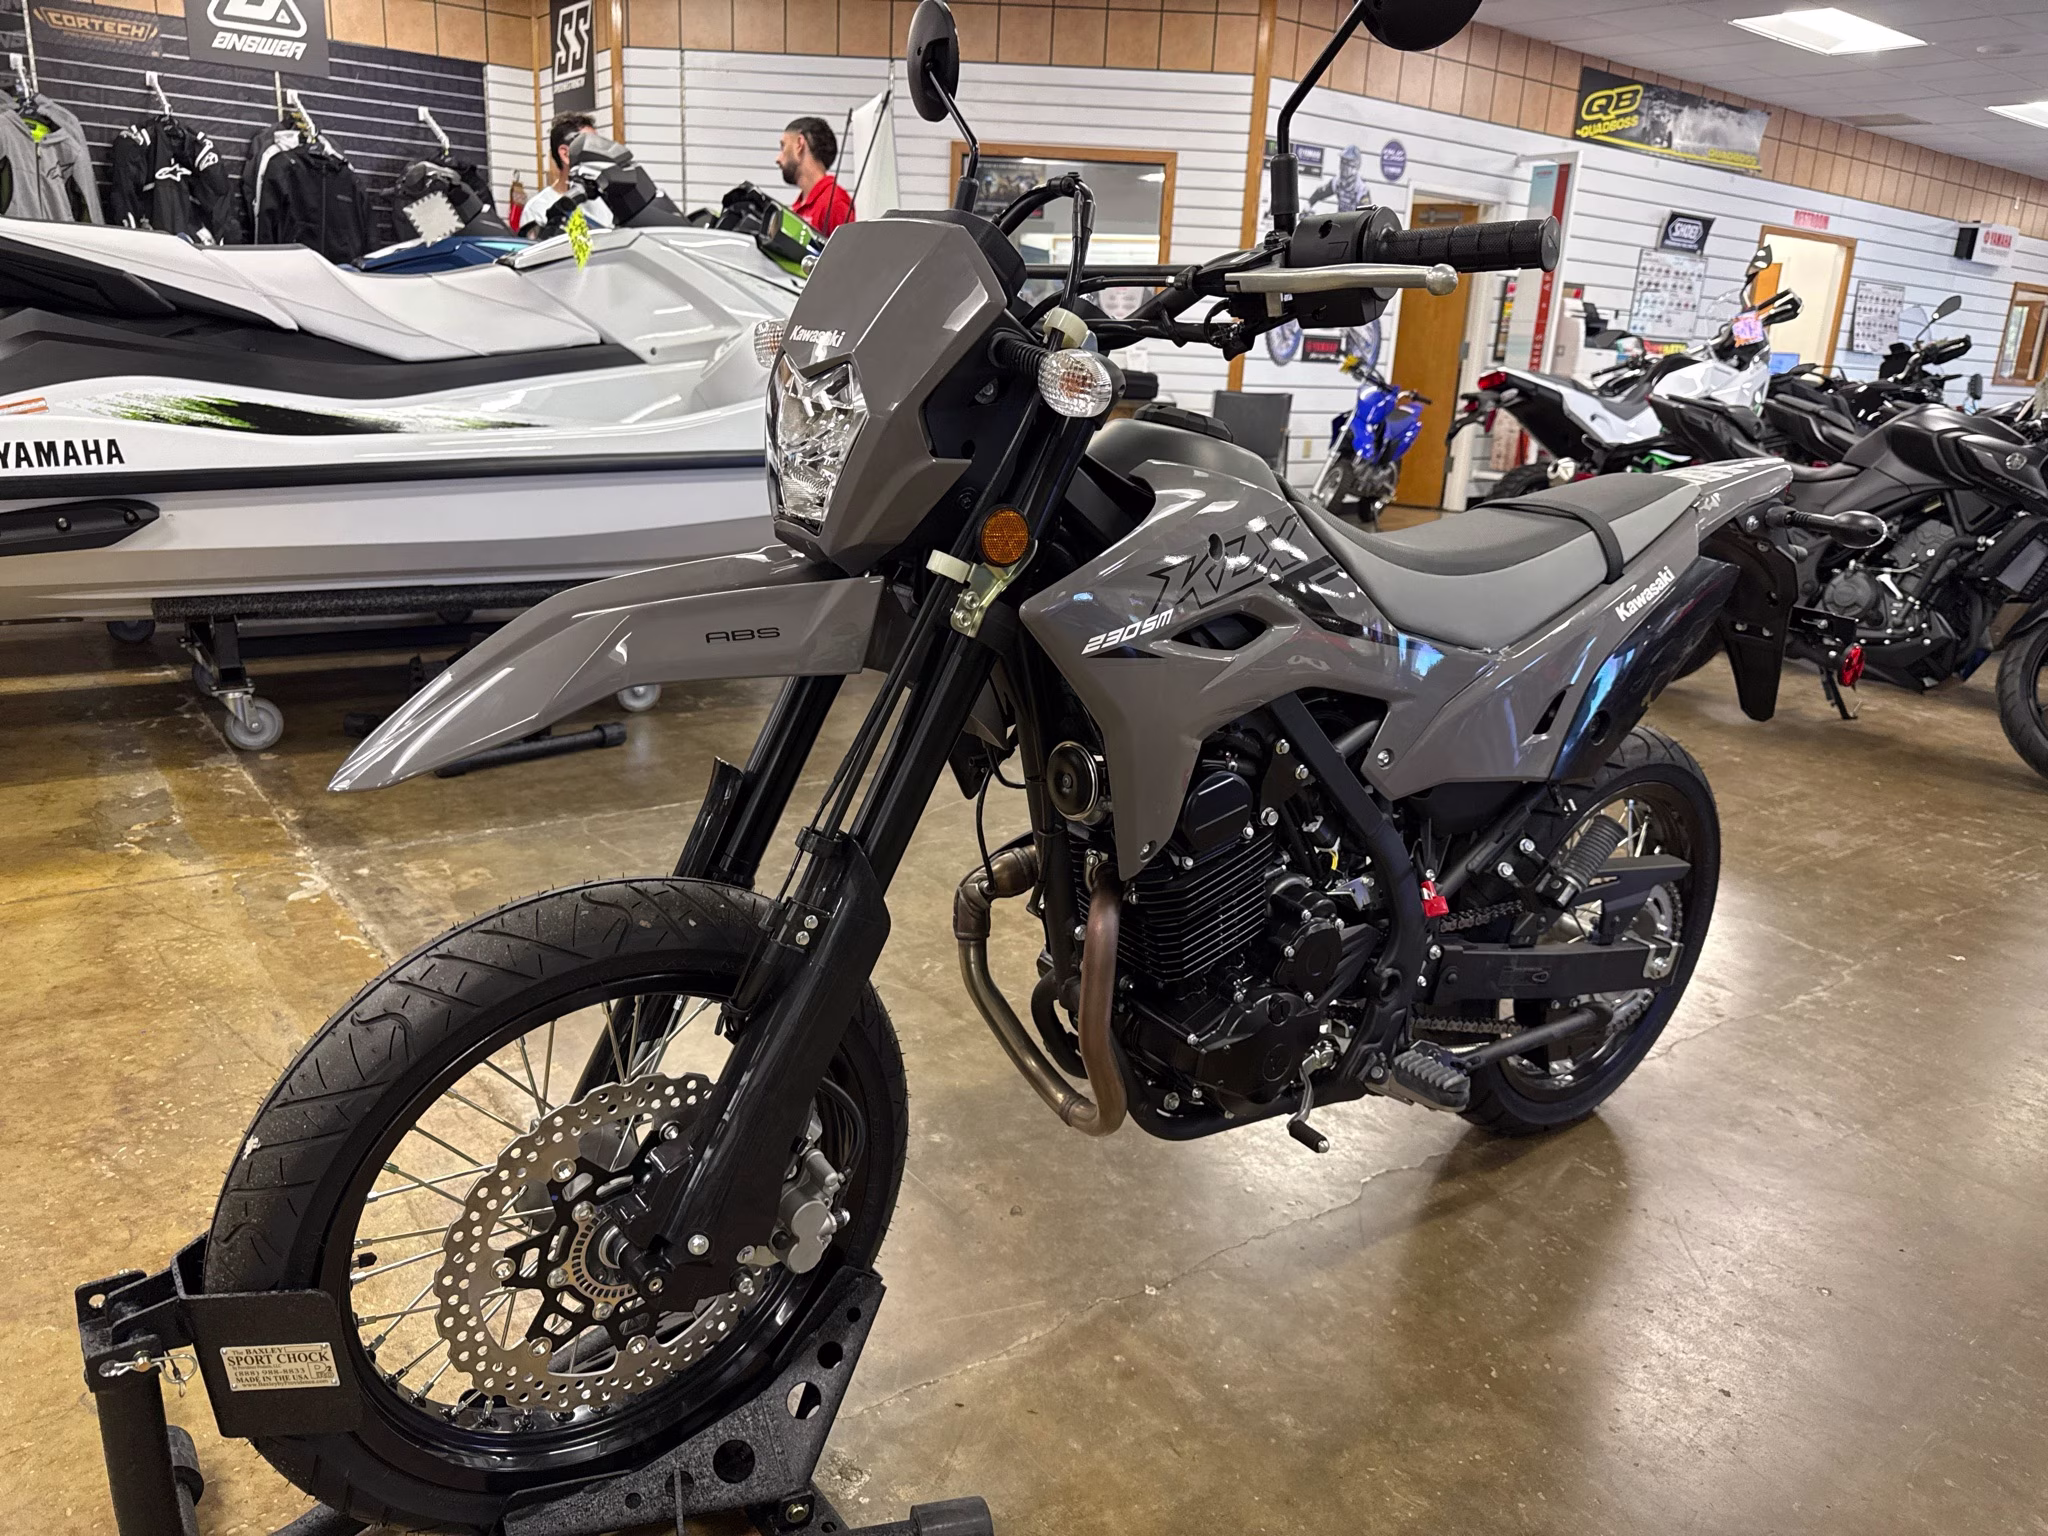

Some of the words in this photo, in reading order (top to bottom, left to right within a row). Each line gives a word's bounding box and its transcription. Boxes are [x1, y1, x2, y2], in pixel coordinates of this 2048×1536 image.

[47, 11, 146, 38] CORTECH
[211, 31, 307, 61] ANSWER
[1581, 84, 1644, 121] QB
[1580, 115, 1640, 138] QUADBOSS
[1672, 221, 1700, 241] SHOEI
[789, 324, 846, 348] Kawasaki
[0, 438, 125, 469] YAMAHA
[1614, 565, 1676, 622] Kawasaki
[705, 627, 781, 644] ABS
[227, 1354, 273, 1367] SPORT
[276, 1351, 330, 1364] CHOCK
[245, 1347, 284, 1356] BAXLEY
[234, 1369, 260, 1377] (888)
[235, 1375, 260, 1383] MADE
[273, 1374, 291, 1382] THE
